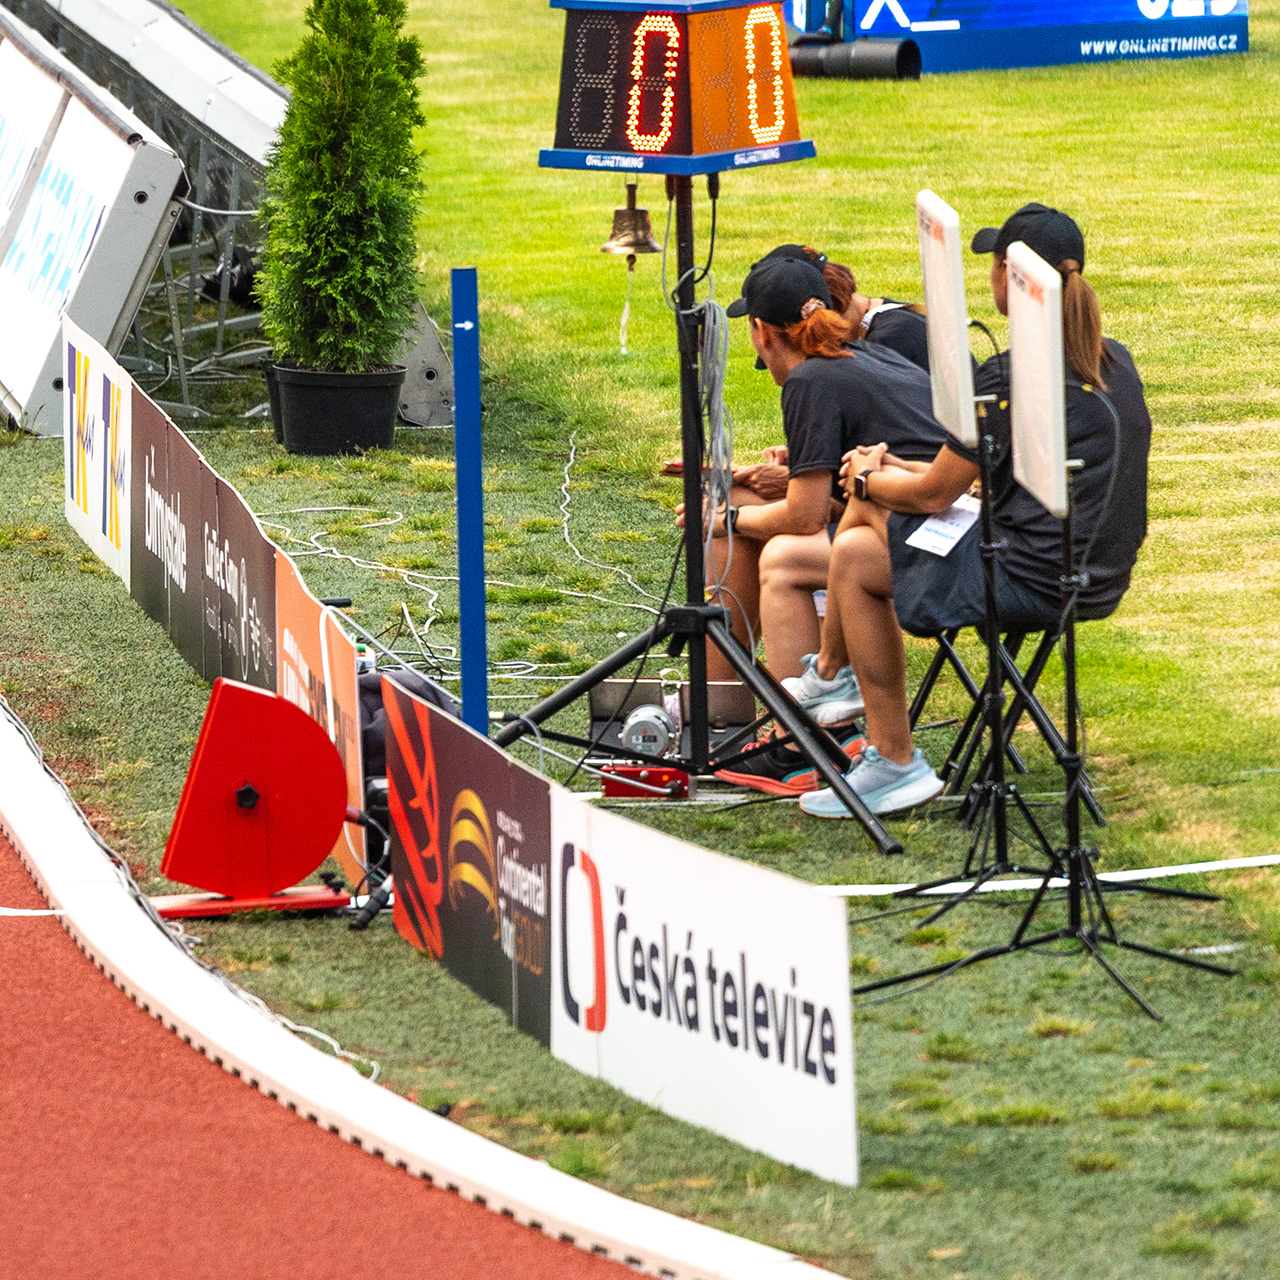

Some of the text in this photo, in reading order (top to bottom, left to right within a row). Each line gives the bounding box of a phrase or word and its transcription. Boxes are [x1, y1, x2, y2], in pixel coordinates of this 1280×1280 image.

[1080, 34, 1238, 57] WWW.ONLINETIMING.CZ
[585, 153, 645, 169] ONLINETIMING
[734, 147, 781, 167] ONLINETIMING
[614, 885, 837, 1087] Česká televize
